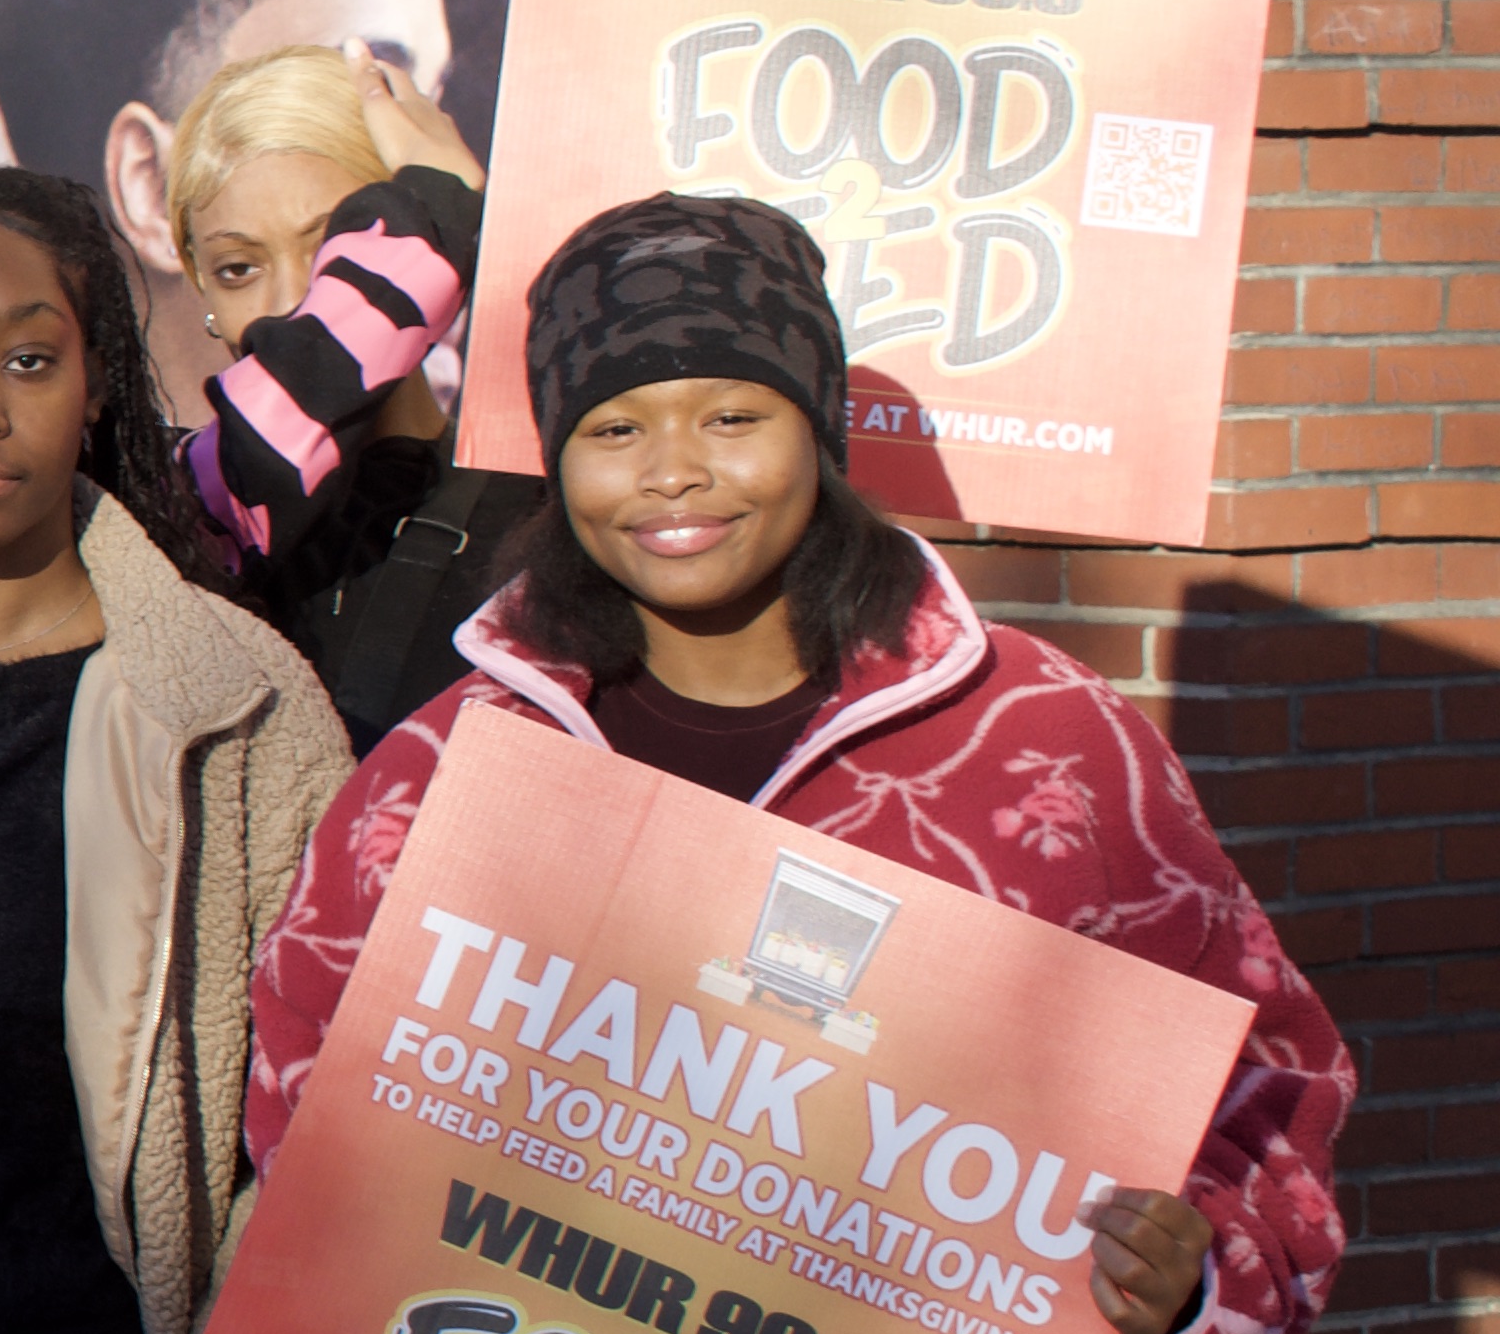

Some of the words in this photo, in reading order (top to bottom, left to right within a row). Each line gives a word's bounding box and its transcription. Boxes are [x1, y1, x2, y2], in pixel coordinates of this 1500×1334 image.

[664, 21, 1076, 200] FOOD
[861, 396, 907, 426] AT
[914, 401, 1107, 448] WHUR.COM
[370, 1072, 414, 1111] TO
[414, 1093, 501, 1144] HELP
[502, 1128, 587, 1181] FEED
[587, 1165, 614, 1197] A
[619, 1176, 738, 1243] FAMILY
[737, 1226, 787, 1262] AT
[380, 1015, 510, 1106] FOR
[524, 1067, 689, 1178] YOUR
[692, 1140, 1061, 1326] DONATIONS
[414, 904, 835, 1156] THANK
[859, 1080, 1122, 1261] YOU
